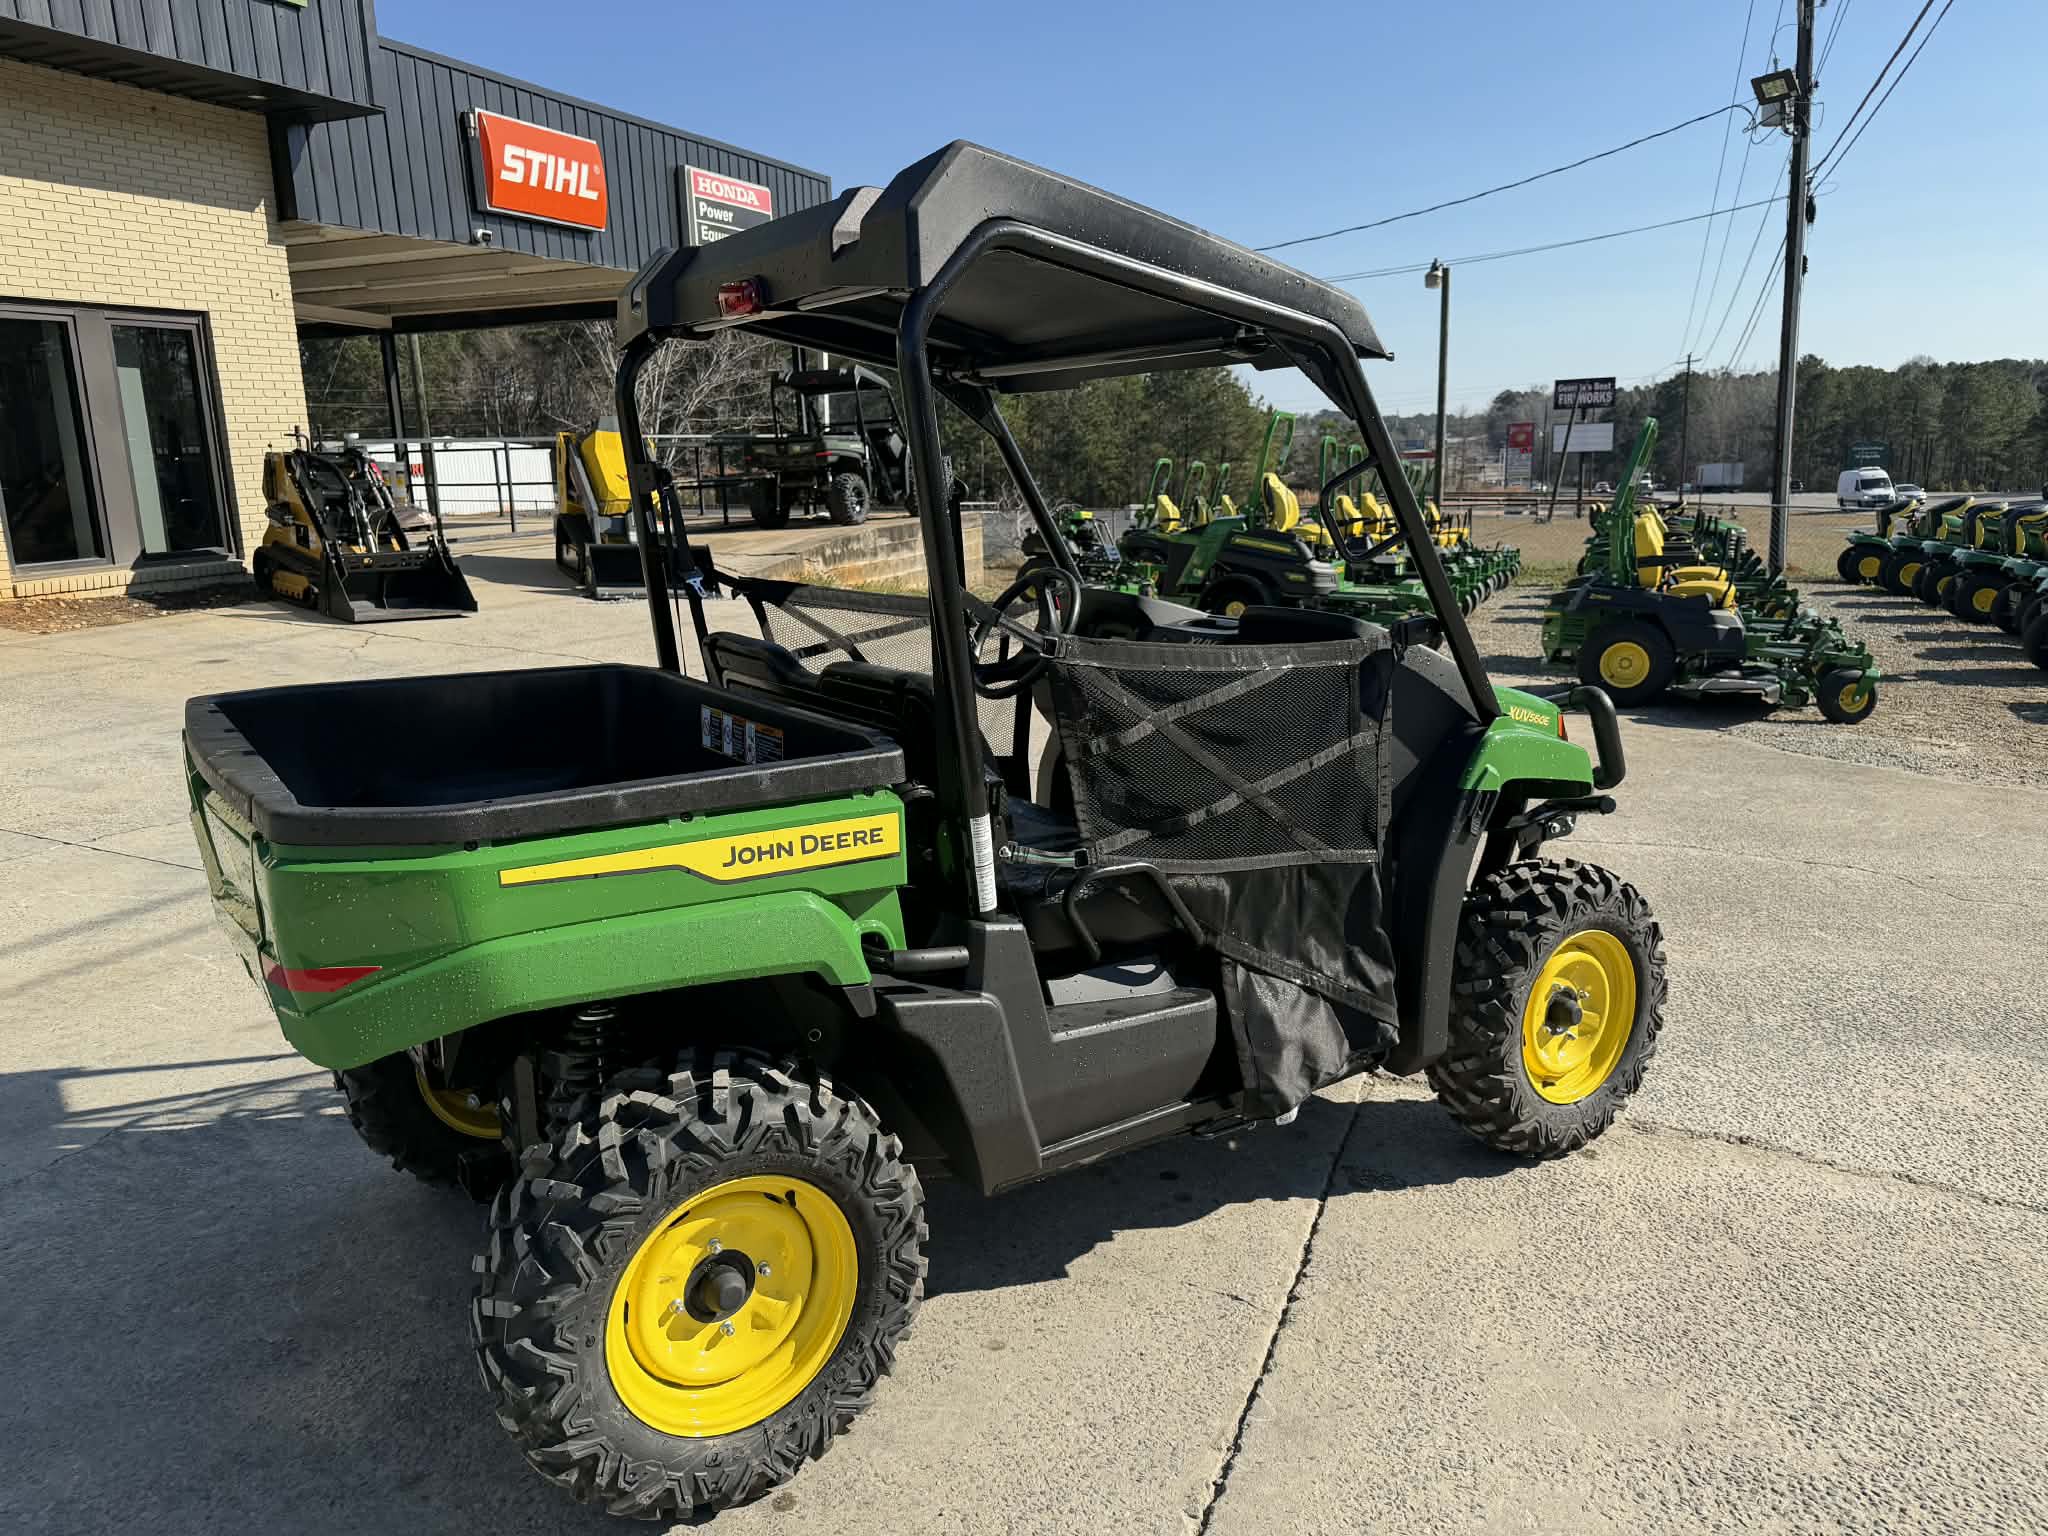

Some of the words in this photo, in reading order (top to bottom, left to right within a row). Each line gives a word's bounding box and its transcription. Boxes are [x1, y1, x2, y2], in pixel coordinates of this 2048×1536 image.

[500, 143, 600, 201] STIHL
[697, 175, 760, 206] HONDA
[699, 201, 735, 223] Power
[722, 840, 794, 868] JOHN
[800, 827, 884, 855] DEERE
